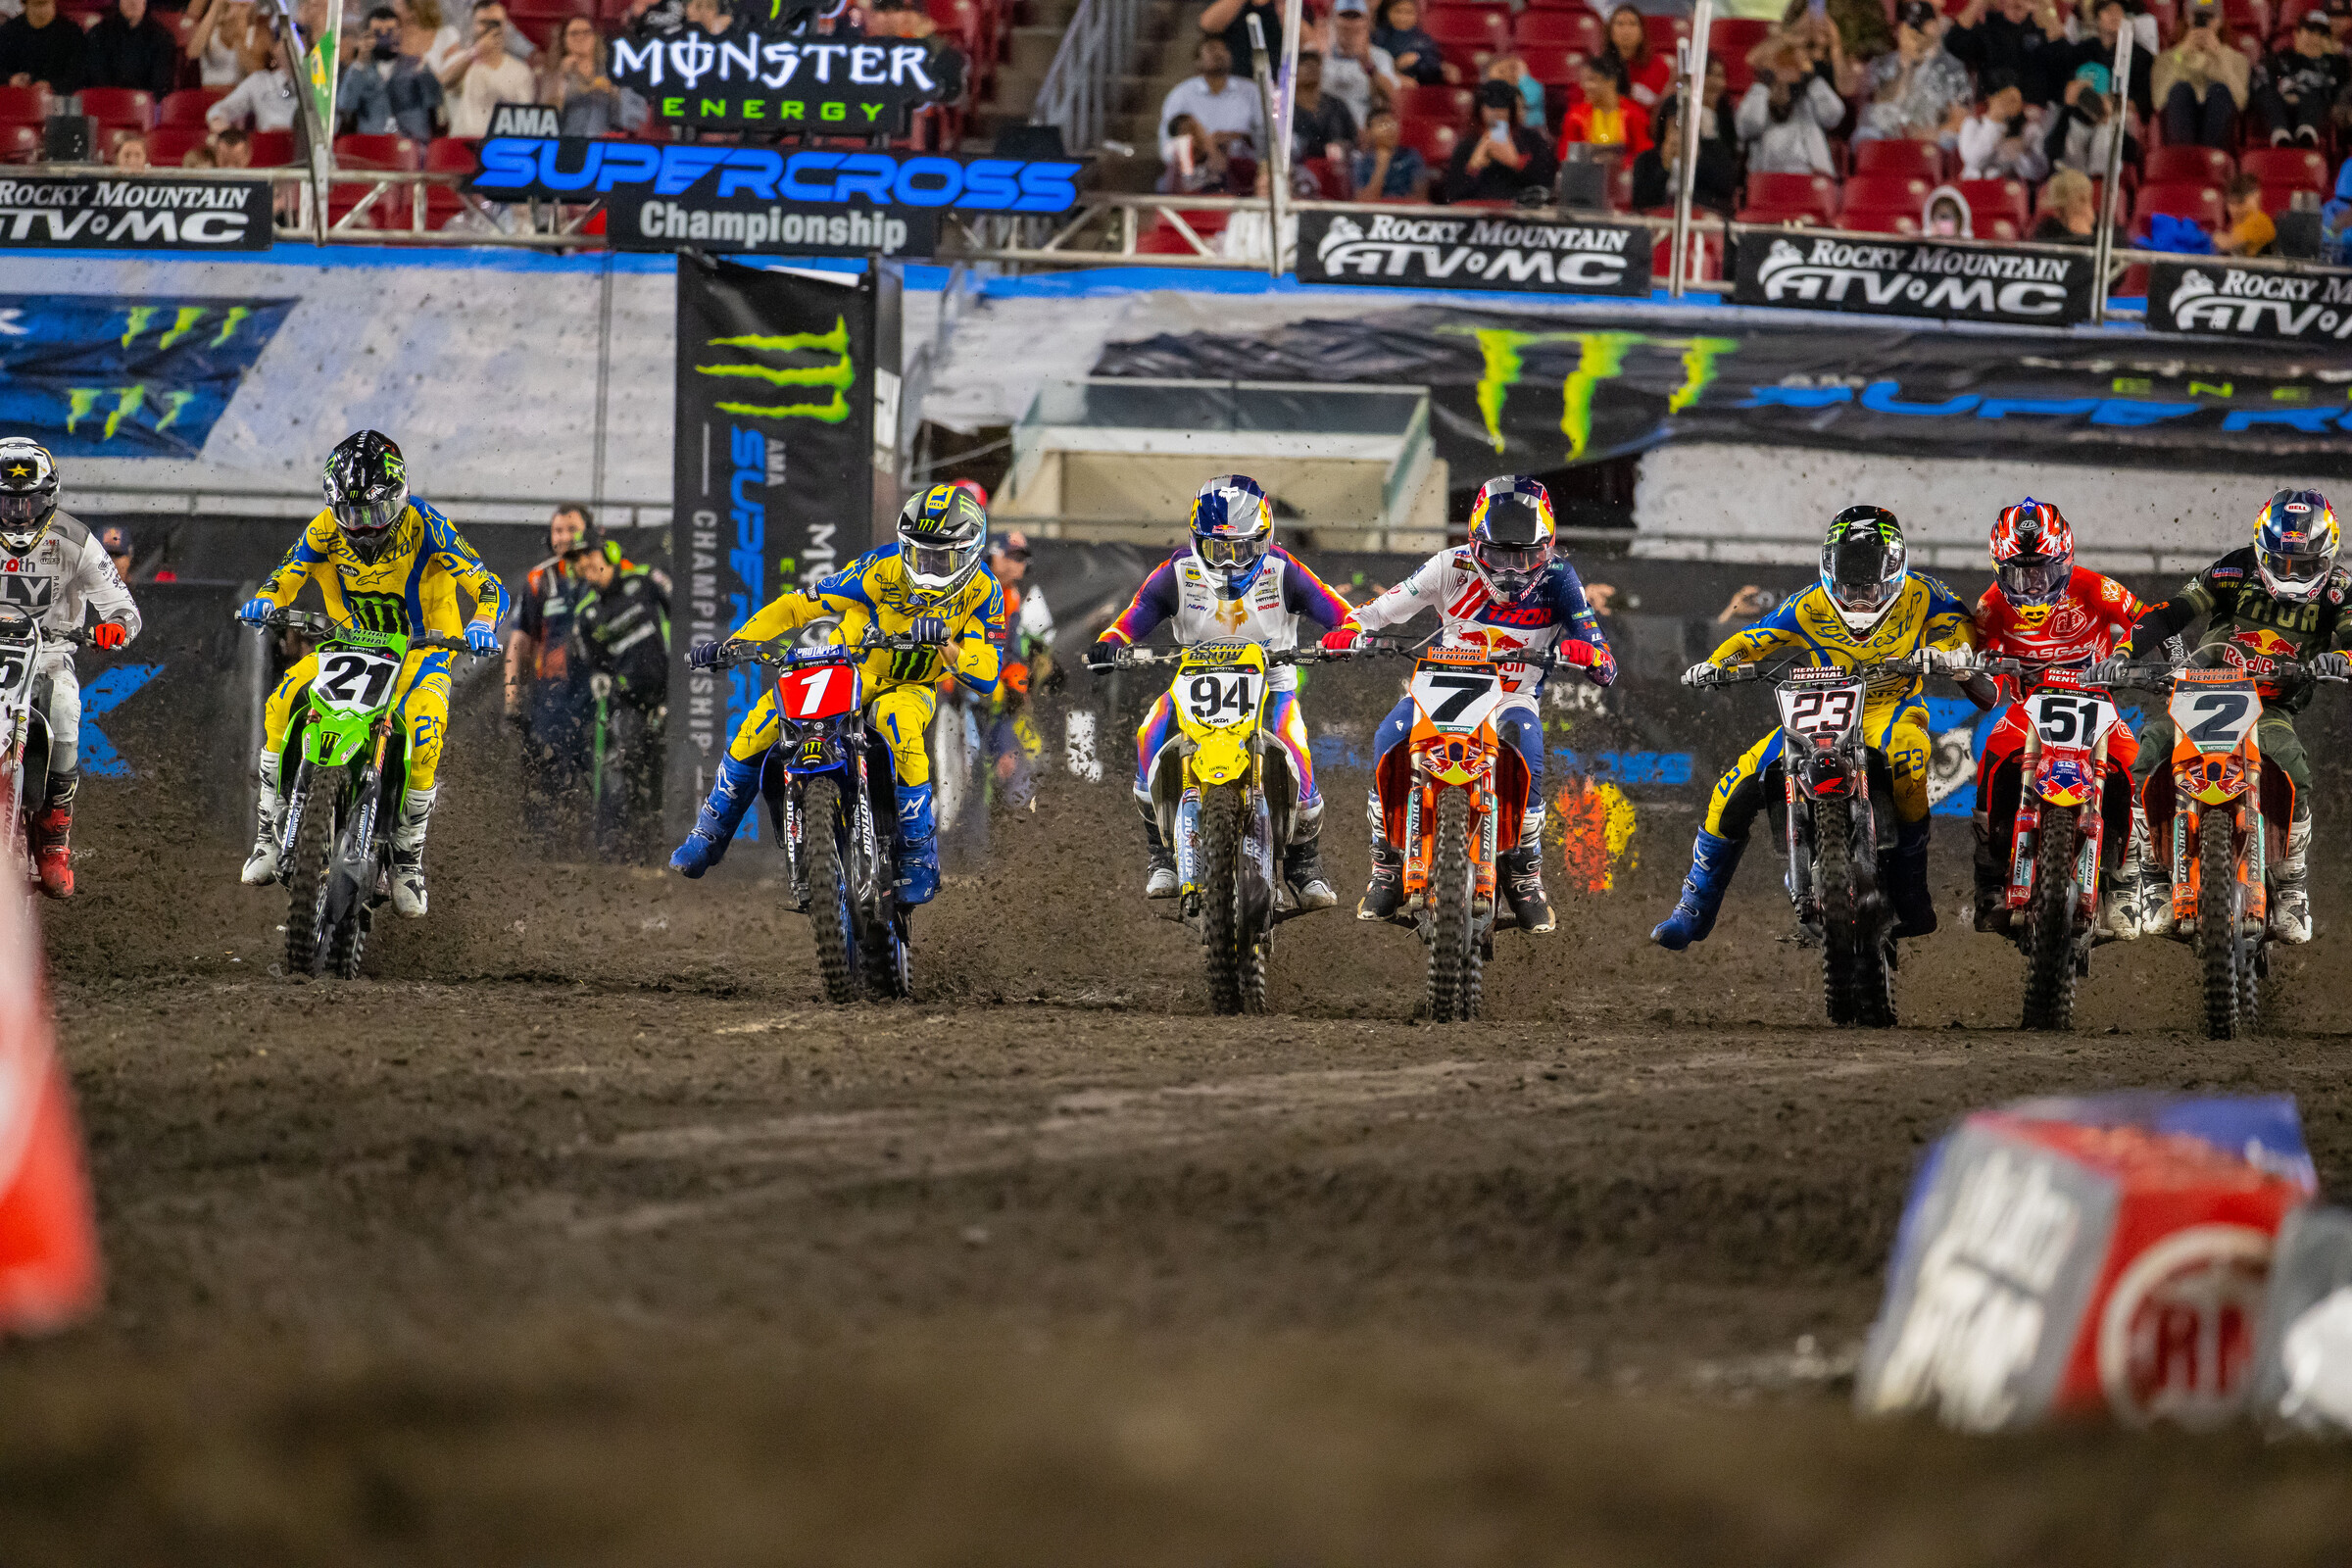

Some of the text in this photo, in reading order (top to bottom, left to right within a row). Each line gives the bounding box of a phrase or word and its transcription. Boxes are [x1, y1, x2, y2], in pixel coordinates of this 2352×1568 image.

[612, 31, 937, 92] MONSTER
[493, 108, 561, 136] AMA
[662, 97, 886, 122] ENERGY
[0, 180, 252, 210] ROCKY MOUNTAIN
[473, 138, 1083, 213] SUPERCROSS
[0, 209, 95, 241] TV
[640, 201, 907, 254] Championship
[1367, 215, 1631, 252] ROCKY MOUNTAIN
[1808, 239, 2072, 282] ROCKY MOUNTAIN
[2219, 269, 2320, 302] ROCKY
[766, 437, 786, 487] AMA
[0, 558, 36, 572] roth
[1257, 602, 1280, 612] SHOWA
[1488, 605, 1552, 626] THOR
[1431, 653, 1485, 662] RENTHAL
[1792, 671, 1845, 680] RENTHAL
[323, 656, 396, 708] 21
[800, 668, 833, 715] 1
[1191, 676, 1255, 717] 94
[1429, 675, 1494, 723] 7
[2047, 675, 2080, 684] RENT
[755, 709, 777, 735] 1
[887, 712, 902, 745] 1
[1789, 690, 1857, 735] 23
[2038, 697, 2100, 749] 51
[2185, 694, 2250, 742] 2
[1893, 749, 1925, 781] 23
[786, 800, 796, 862] DUNOP
[859, 793, 872, 858] DUNLOP
[1411, 804, 1421, 858] DUNP
[1483, 796, 1492, 852] DUNLP
[2086, 848, 2095, 888] DUNLOP
[2178, 829, 2187, 884] DUNLOP
